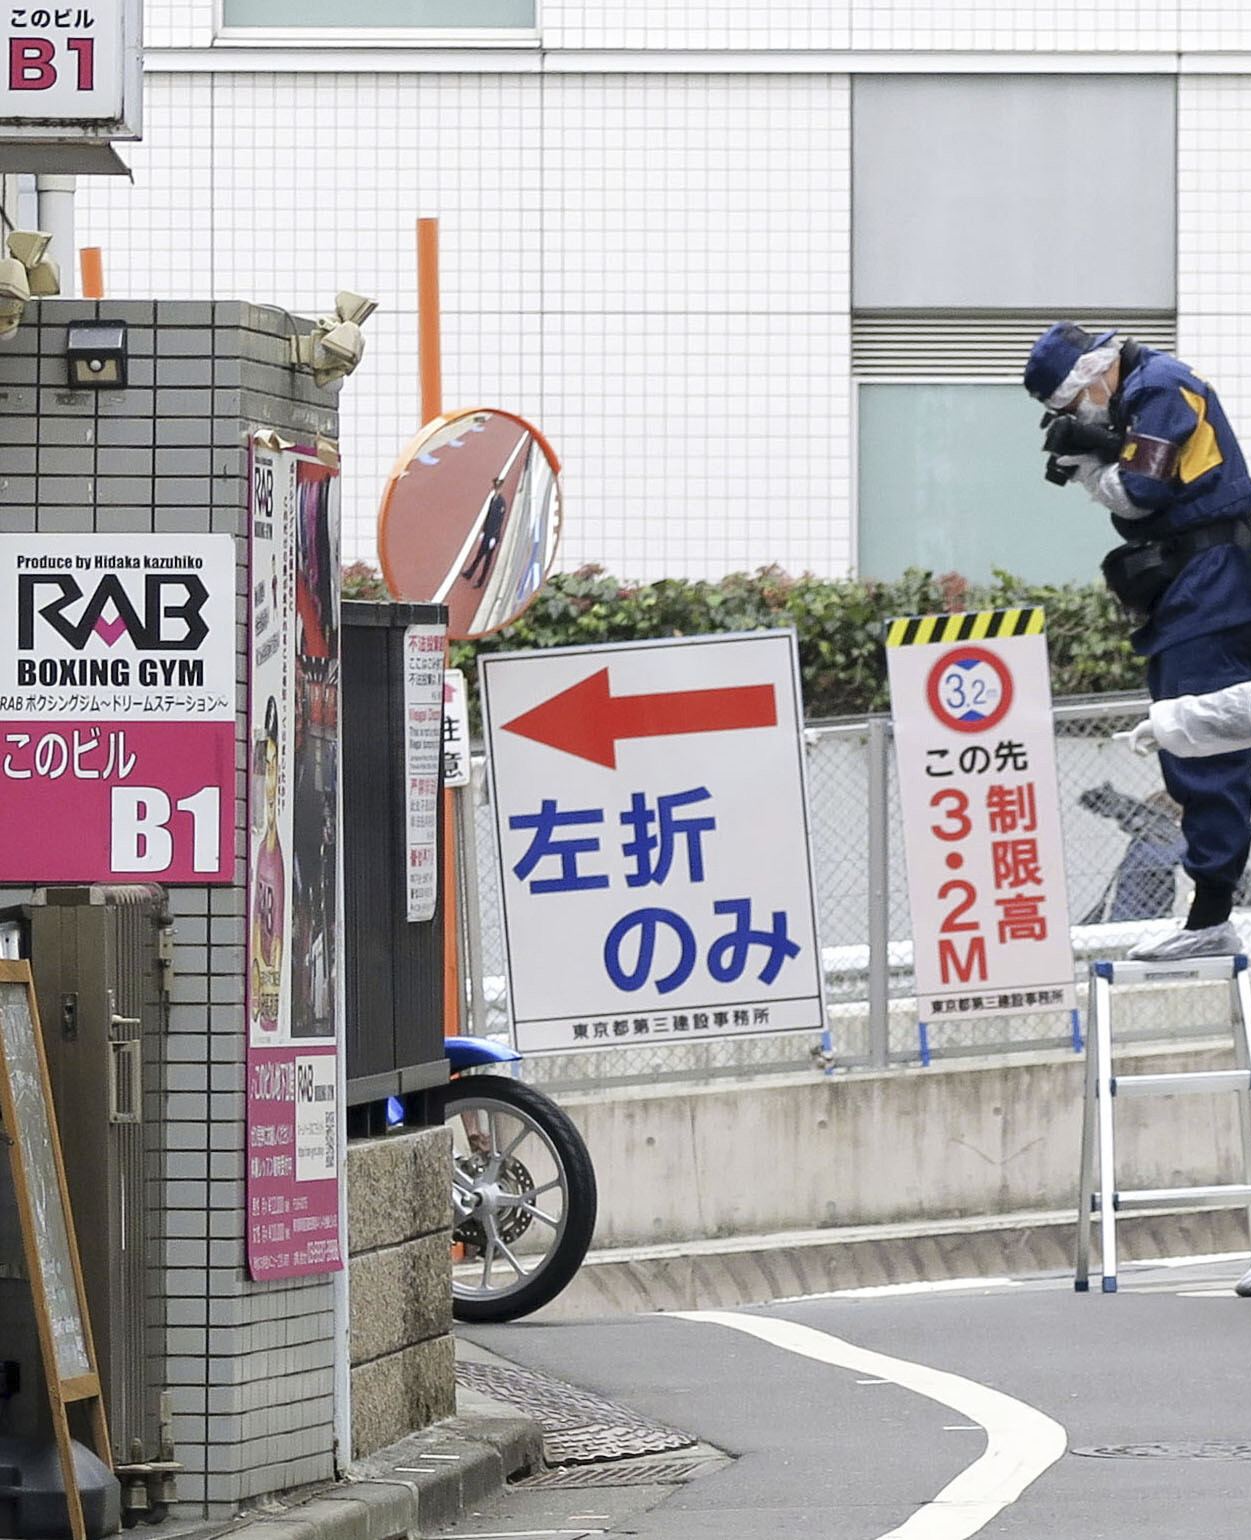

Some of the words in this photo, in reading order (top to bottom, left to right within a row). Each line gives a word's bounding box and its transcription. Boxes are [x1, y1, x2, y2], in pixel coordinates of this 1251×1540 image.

[9, 8, 95, 28] このビル
[8, 36, 95, 91] B1
[17, 555, 72, 569] Produce
[75, 555, 91, 570] by
[94, 555, 140, 569] Hidaka
[144, 555, 203, 569] kazuhiko
[18, 573, 210, 650] RAB
[18, 659, 130, 687] BOXING
[139, 659, 204, 687] GYM
[0, 696, 23, 711] RAB
[3, 727, 137, 780] このビル
[925, 741, 1029, 778] この先
[111, 787, 220, 873] B1
[508, 785, 716, 895] 左折
[986, 782, 1047, 944] 制限高
[603, 897, 801, 994] のみ
[572, 1007, 771, 1041] 東京都第三建設事務所
[931, 990, 1064, 1015] 東京都第三建設事務所
